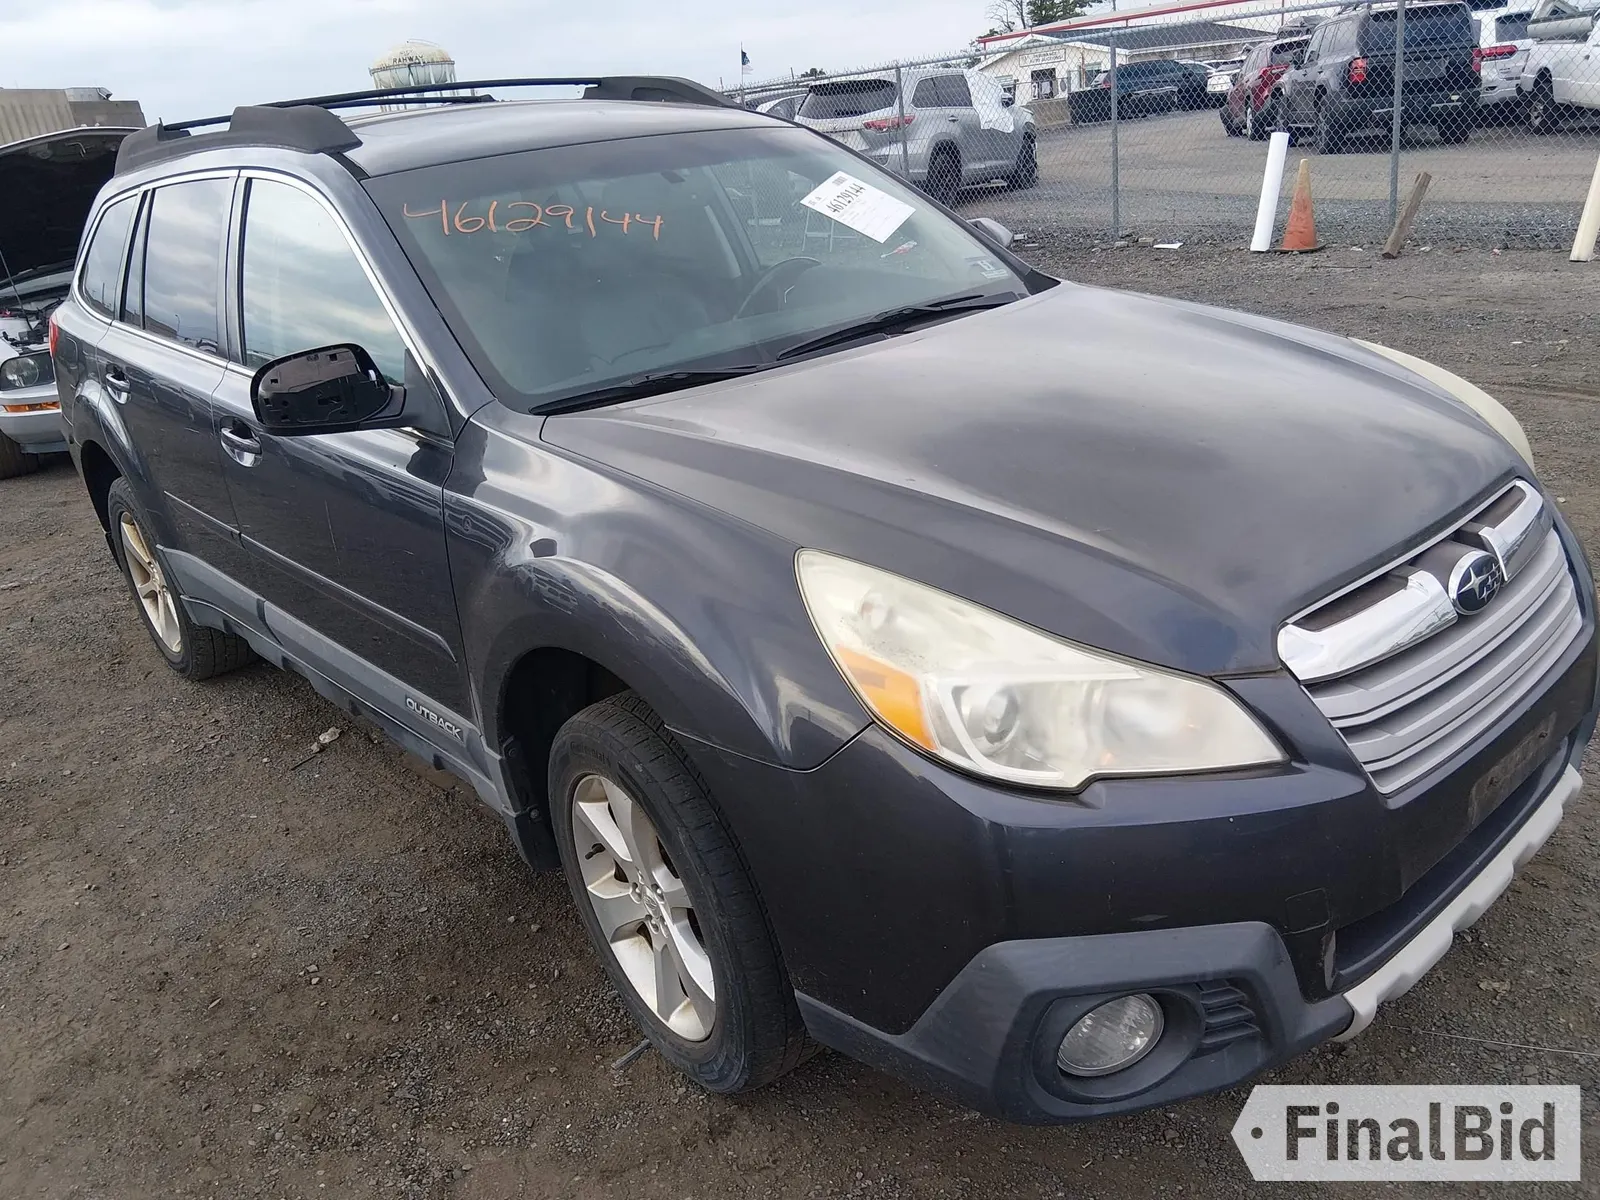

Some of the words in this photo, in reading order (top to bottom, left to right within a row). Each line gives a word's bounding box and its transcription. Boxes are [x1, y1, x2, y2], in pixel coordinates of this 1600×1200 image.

[392, 54, 424, 64] RAHWAY
[825, 182, 867, 213] 46129144
[403, 199, 664, 241] 46129144
[406, 697, 461, 740] OUTBACK
